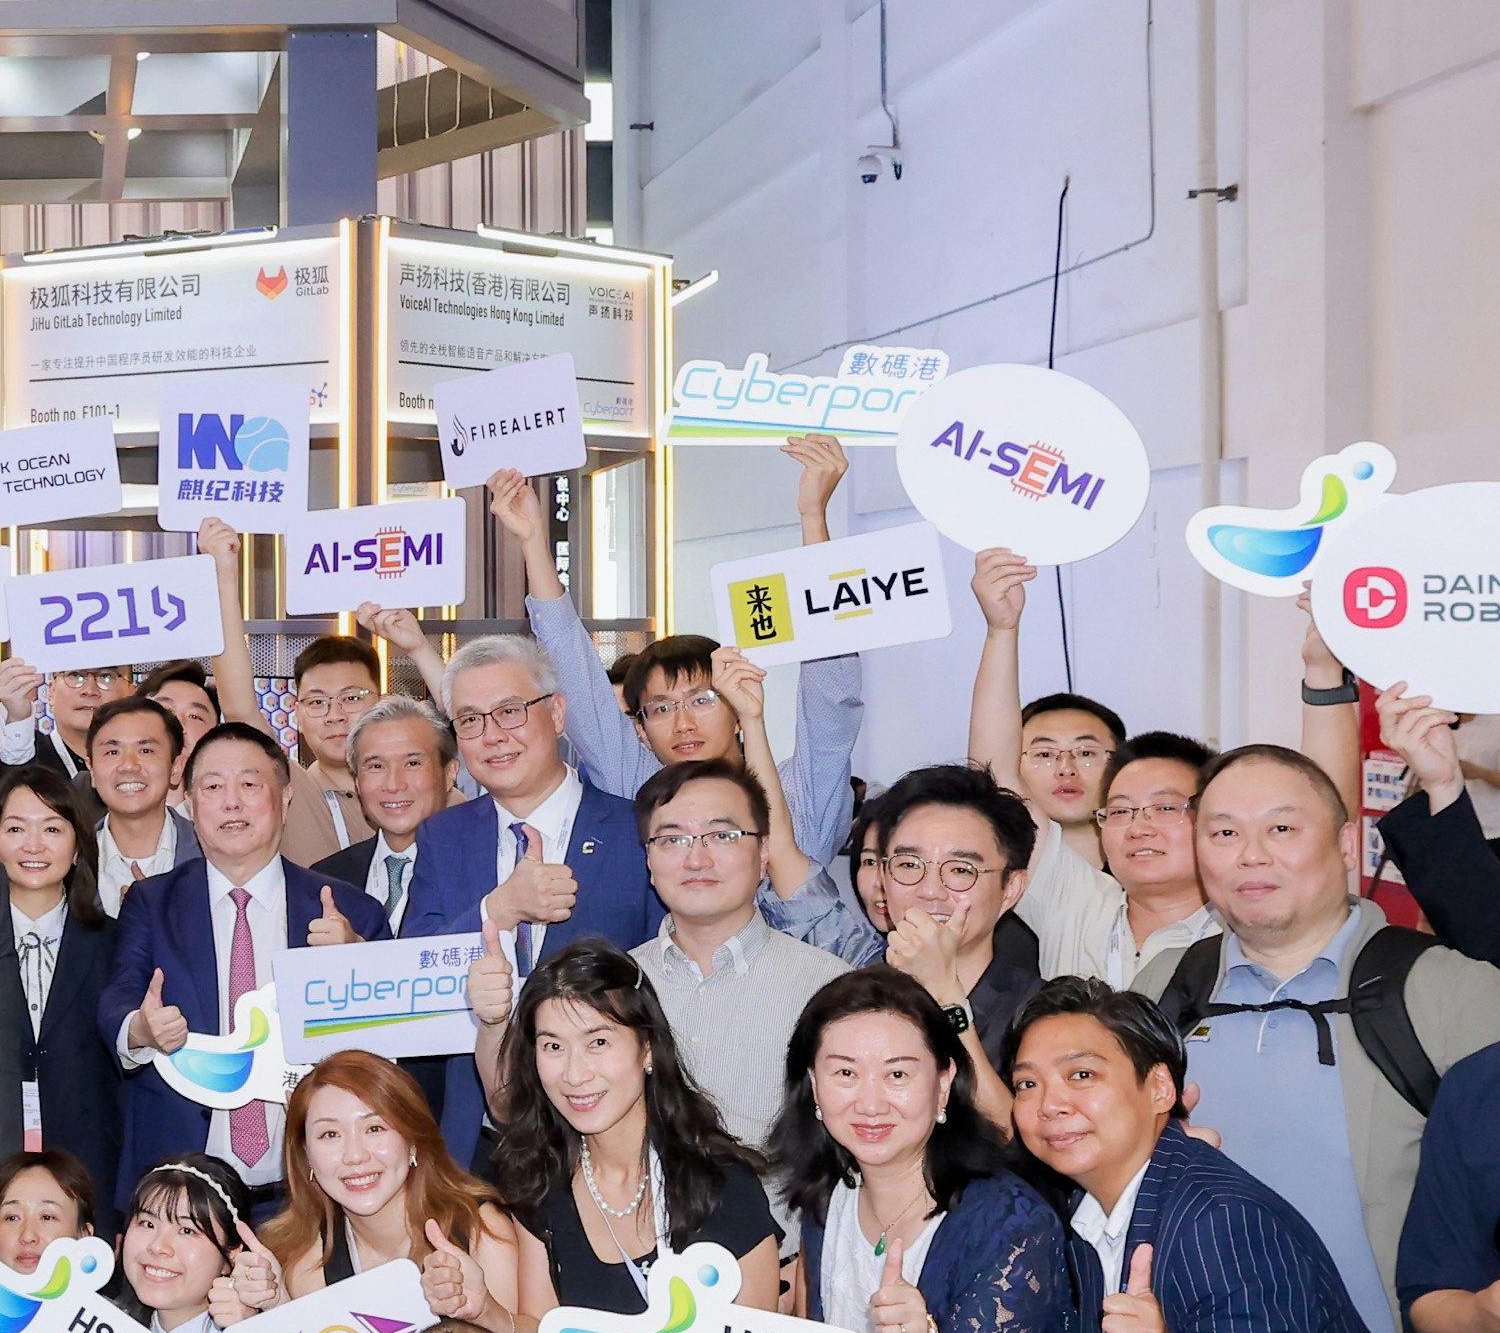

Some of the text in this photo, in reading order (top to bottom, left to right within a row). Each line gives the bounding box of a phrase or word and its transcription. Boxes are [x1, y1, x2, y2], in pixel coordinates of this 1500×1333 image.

[294, 265, 329, 285] 极狐
[399, 262, 571, 307] 声扬科技(香港)有限公司
[30, 273, 201, 310] 极狐科技有限公司
[295, 285, 329, 297] GitLab
[30, 306, 183, 332] JiHu GitLab Technology Limited
[400, 294, 565, 327] VoiceAI Technologies Hong Kong Limited
[588, 304, 634, 322] 声扬科技
[30, 344, 257, 372] 一家专注提升中国程序员研发效能的科技企业
[847, 350, 942, 382] 數碼港
[399, 391, 424, 409] Booth
[583, 401, 634, 417] Cyberport
[681, 362, 905, 428] Cyberpor
[30, 407, 60, 424] Booth
[470, 406, 567, 442] FIREALERT
[0, 452, 71, 473] K OCEAN
[930, 420, 1106, 512] AI-SEMI
[1, 467, 106, 494] TECHNOLOGY
[177, 478, 285, 504] 麒纪科技
[304, 529, 444, 577] AI-SEMI
[805, 566, 929, 616] LAIYE
[745, 583, 778, 641] 来也
[418, 946, 484, 970] 數碼港
[304, 969, 468, 1013] Cyberpor
